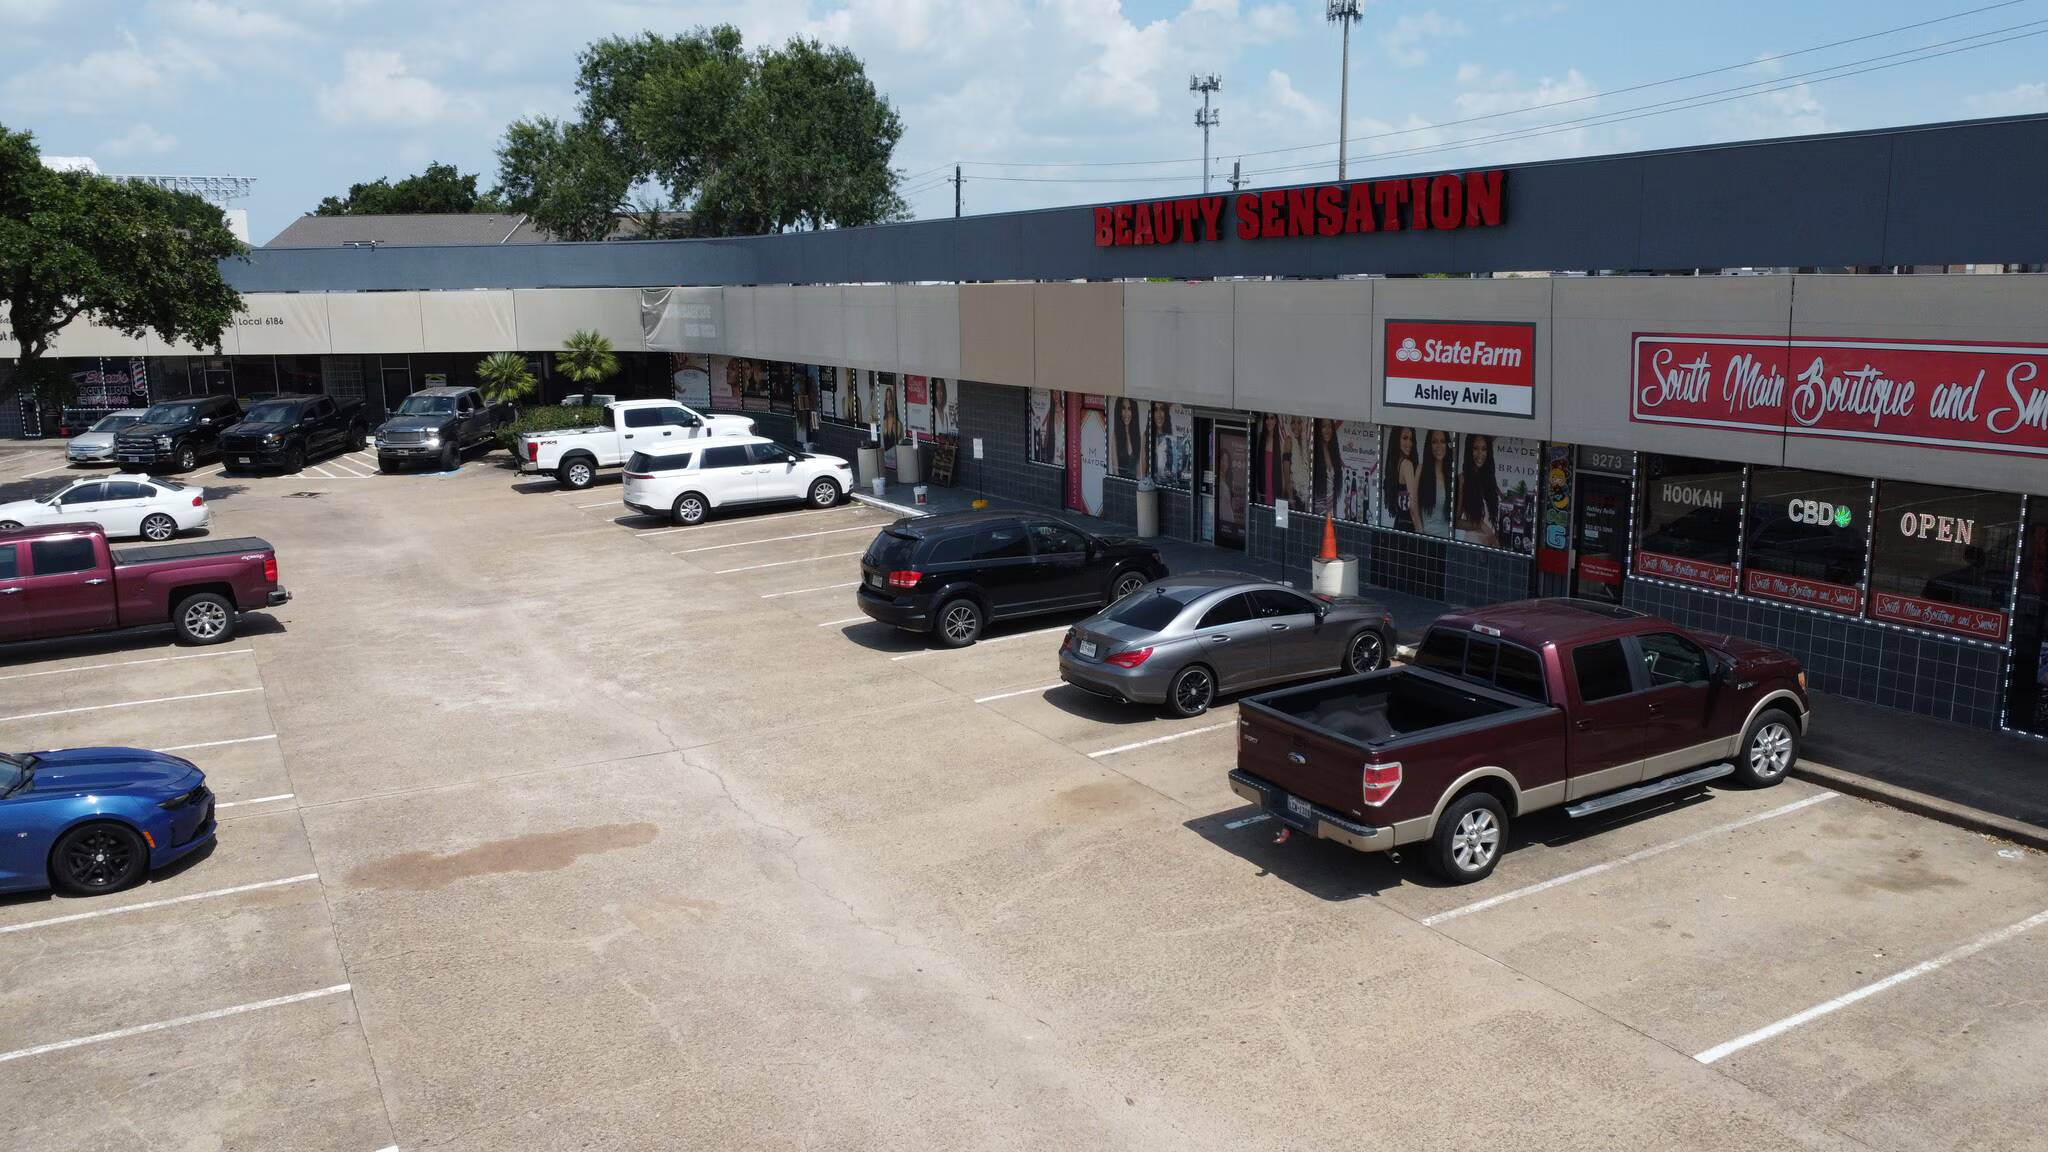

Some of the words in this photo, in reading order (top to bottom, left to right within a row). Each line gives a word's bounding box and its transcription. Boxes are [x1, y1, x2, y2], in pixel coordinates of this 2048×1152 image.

[1094, 198, 1224, 247] BEAUTY
[1236, 170, 1506, 240] SENSATION
[238, 317, 261, 326] Local
[265, 317, 284, 326] 6186
[1414, 383, 1458, 405] Ashley
[1462, 387, 1497, 405] Avila
[1641, 348, 1711, 407] South
[1722, 353, 1785, 414] Main
[1791, 356, 1915, 428] Boutique
[1929, 369, 1985, 422] and
[1343, 427, 1375, 438] MAYDE
[1497, 446, 1537, 456] MAYDE
[1592, 453, 1622, 469] 9273
[1663, 484, 1723, 509] HOOKAH
[1788, 498, 1834, 526] CBD
[1900, 512, 1975, 545] OPEN
[1878, 597, 1900, 614] South
[1903, 602, 1921, 616] Main
[1922, 606, 1955, 625] Boutique
[1957, 615, 1971, 626] and
[1971, 614, 1998, 630] Smoke
